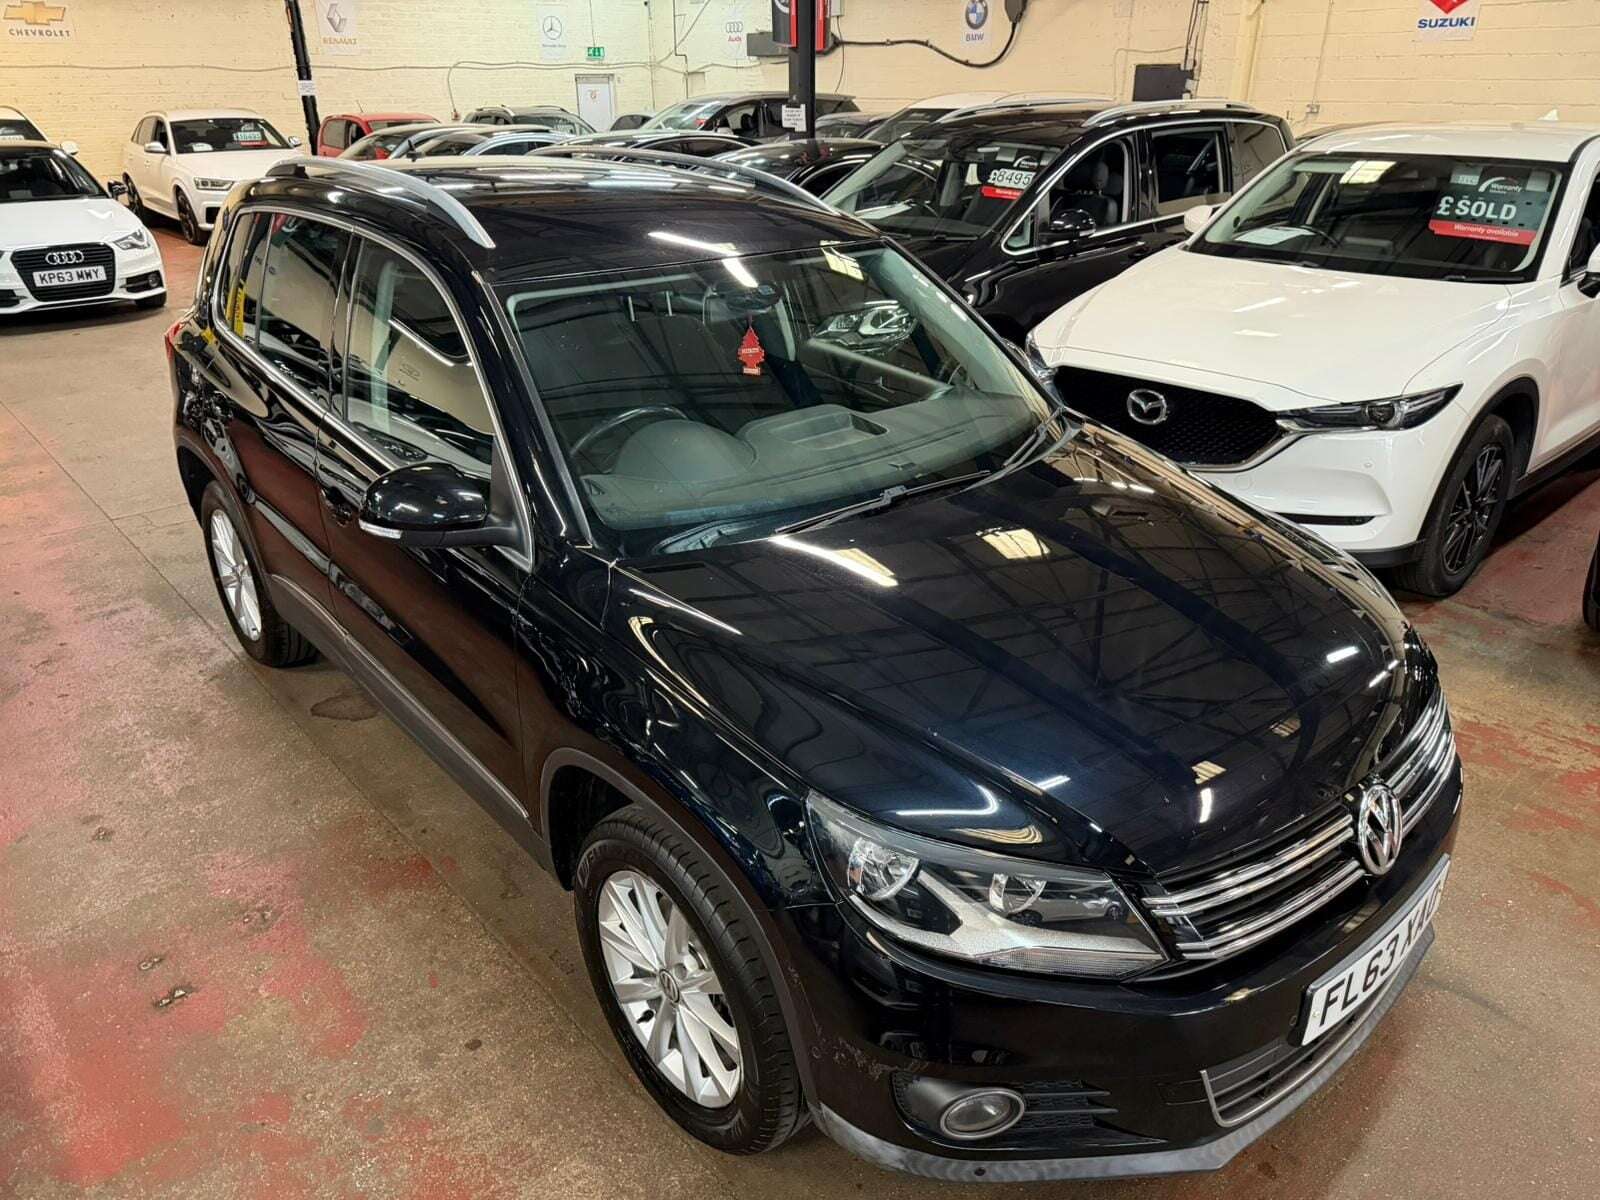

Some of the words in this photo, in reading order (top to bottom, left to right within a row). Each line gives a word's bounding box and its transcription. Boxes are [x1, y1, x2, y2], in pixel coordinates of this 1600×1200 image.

[1417, 17, 1475, 28] SUZUKI
[8, 28, 71, 37] CHEVROLET
[965, 33, 984, 41] BMW
[1454, 199, 1517, 220] SOLD
[39, 270, 74, 284] KP63
[1319, 933, 1400, 1027] FL63
